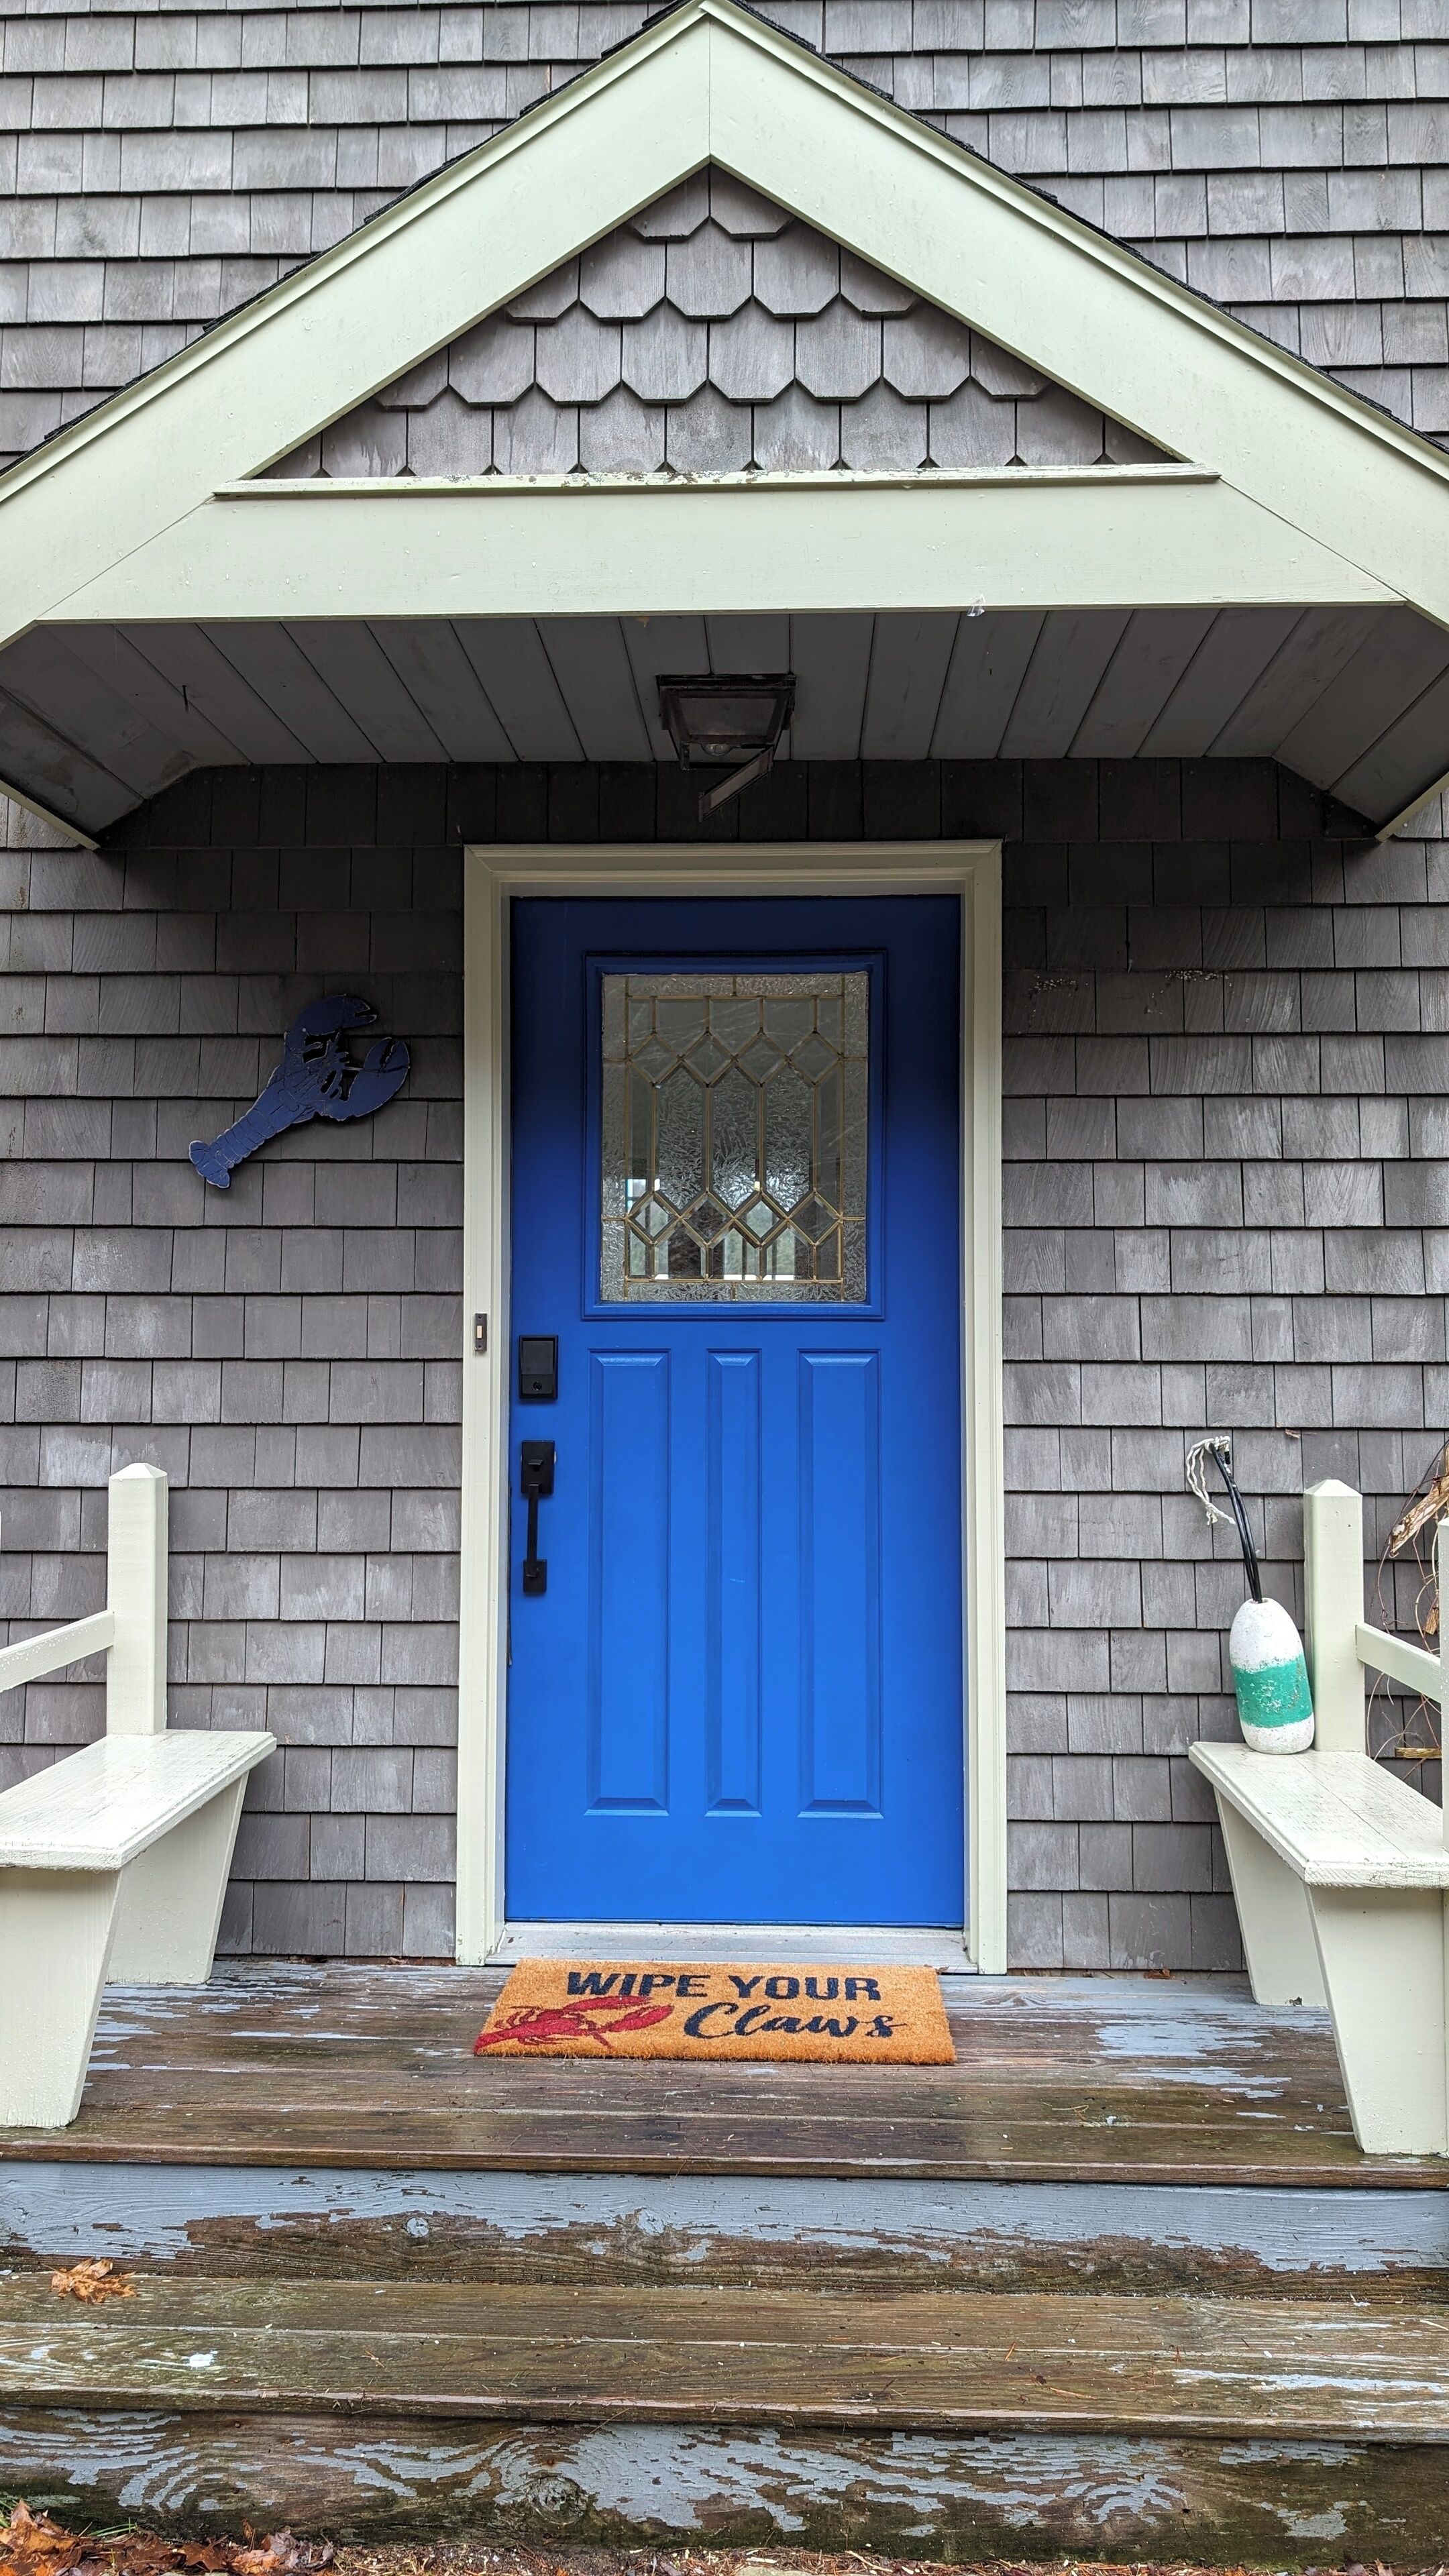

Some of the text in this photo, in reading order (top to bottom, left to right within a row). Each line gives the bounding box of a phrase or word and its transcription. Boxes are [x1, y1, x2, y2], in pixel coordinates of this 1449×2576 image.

[566, 1971, 881, 2000] WIPE YOUR
[683, 2001, 908, 2040] Claws
